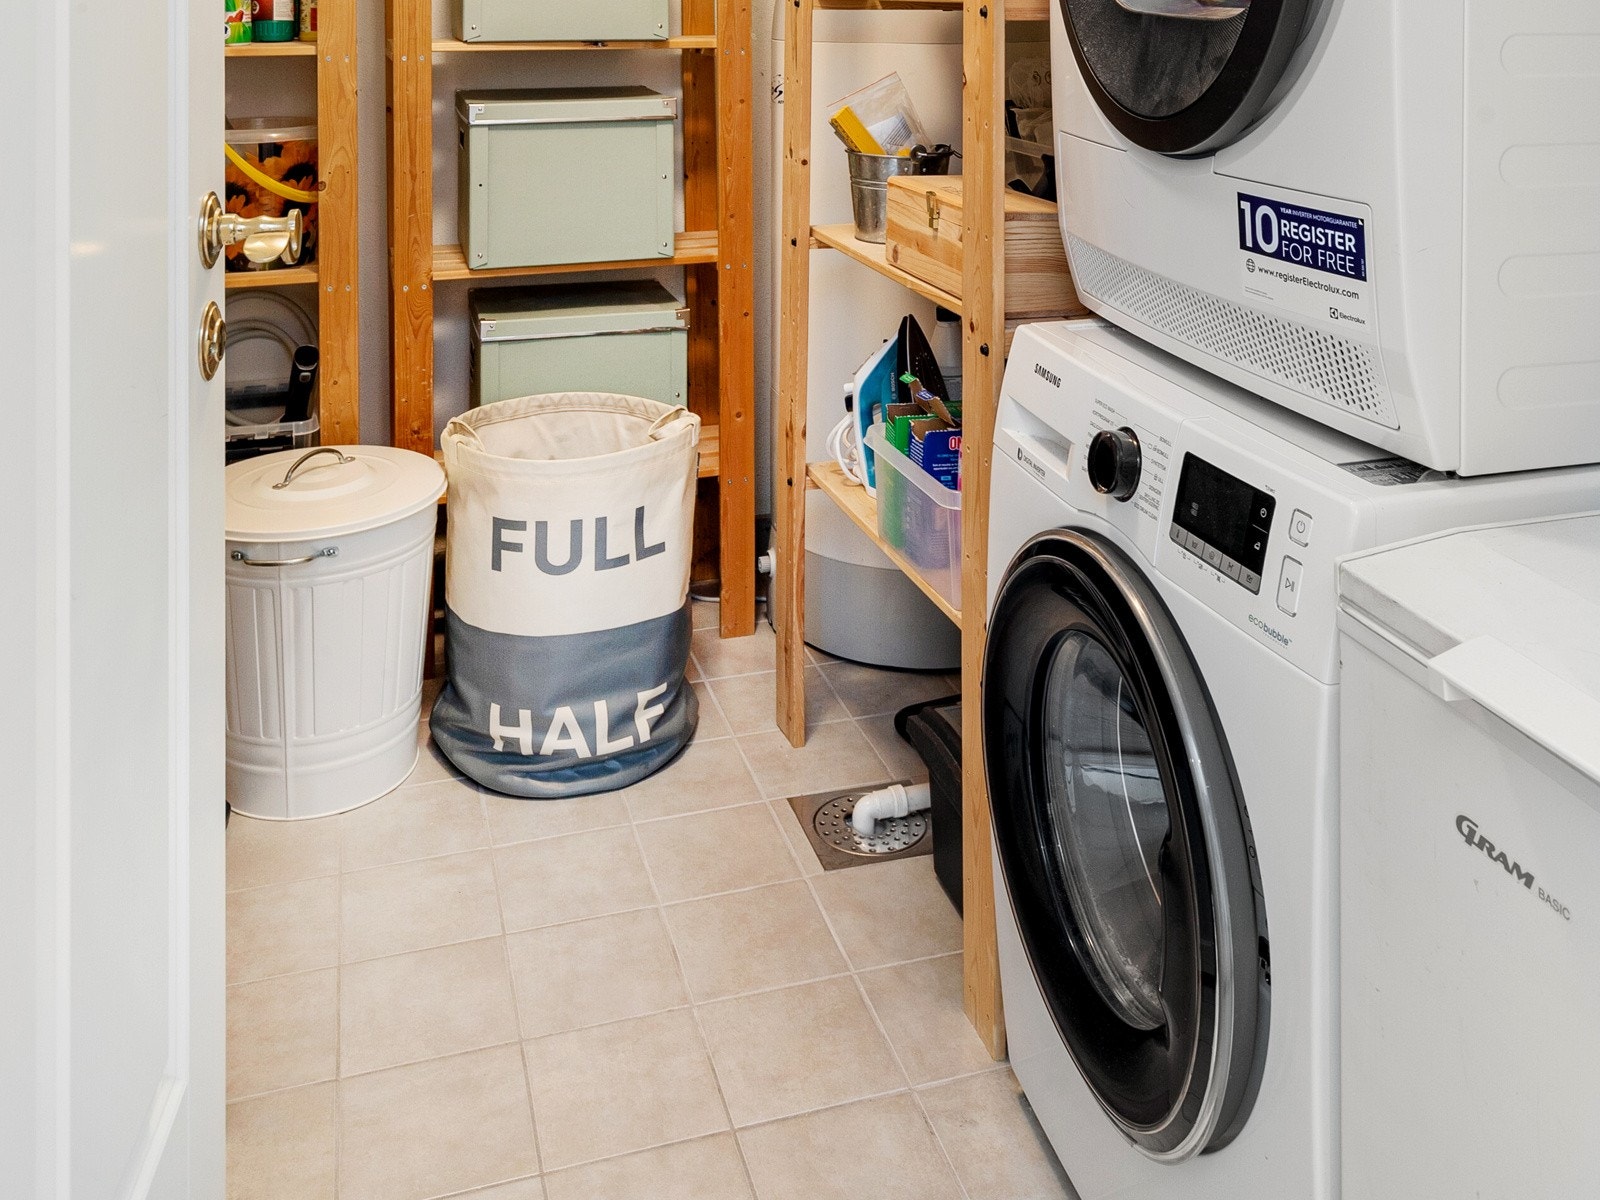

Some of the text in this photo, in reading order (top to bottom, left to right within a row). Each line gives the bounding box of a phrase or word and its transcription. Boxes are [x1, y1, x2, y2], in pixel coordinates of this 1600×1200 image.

[1240, 200, 1279, 254] 10
[1280, 207, 1292, 215] YEAR
[1292, 210, 1313, 219] INVERTER
[1281, 219, 1357, 253] REGISTER
[1282, 241, 1313, 265] FOR
[1318, 249, 1356, 275] FREE
[1258, 266, 1360, 300] www.registerElectrolux.com
[1339, 312, 1366, 325] Electrolux
[1034, 363, 1061, 388] SAMSUNG
[491, 506, 666, 576] FULL
[489, 682, 667, 759] HALF
[1456, 814, 1571, 921] GRAM BASIC
